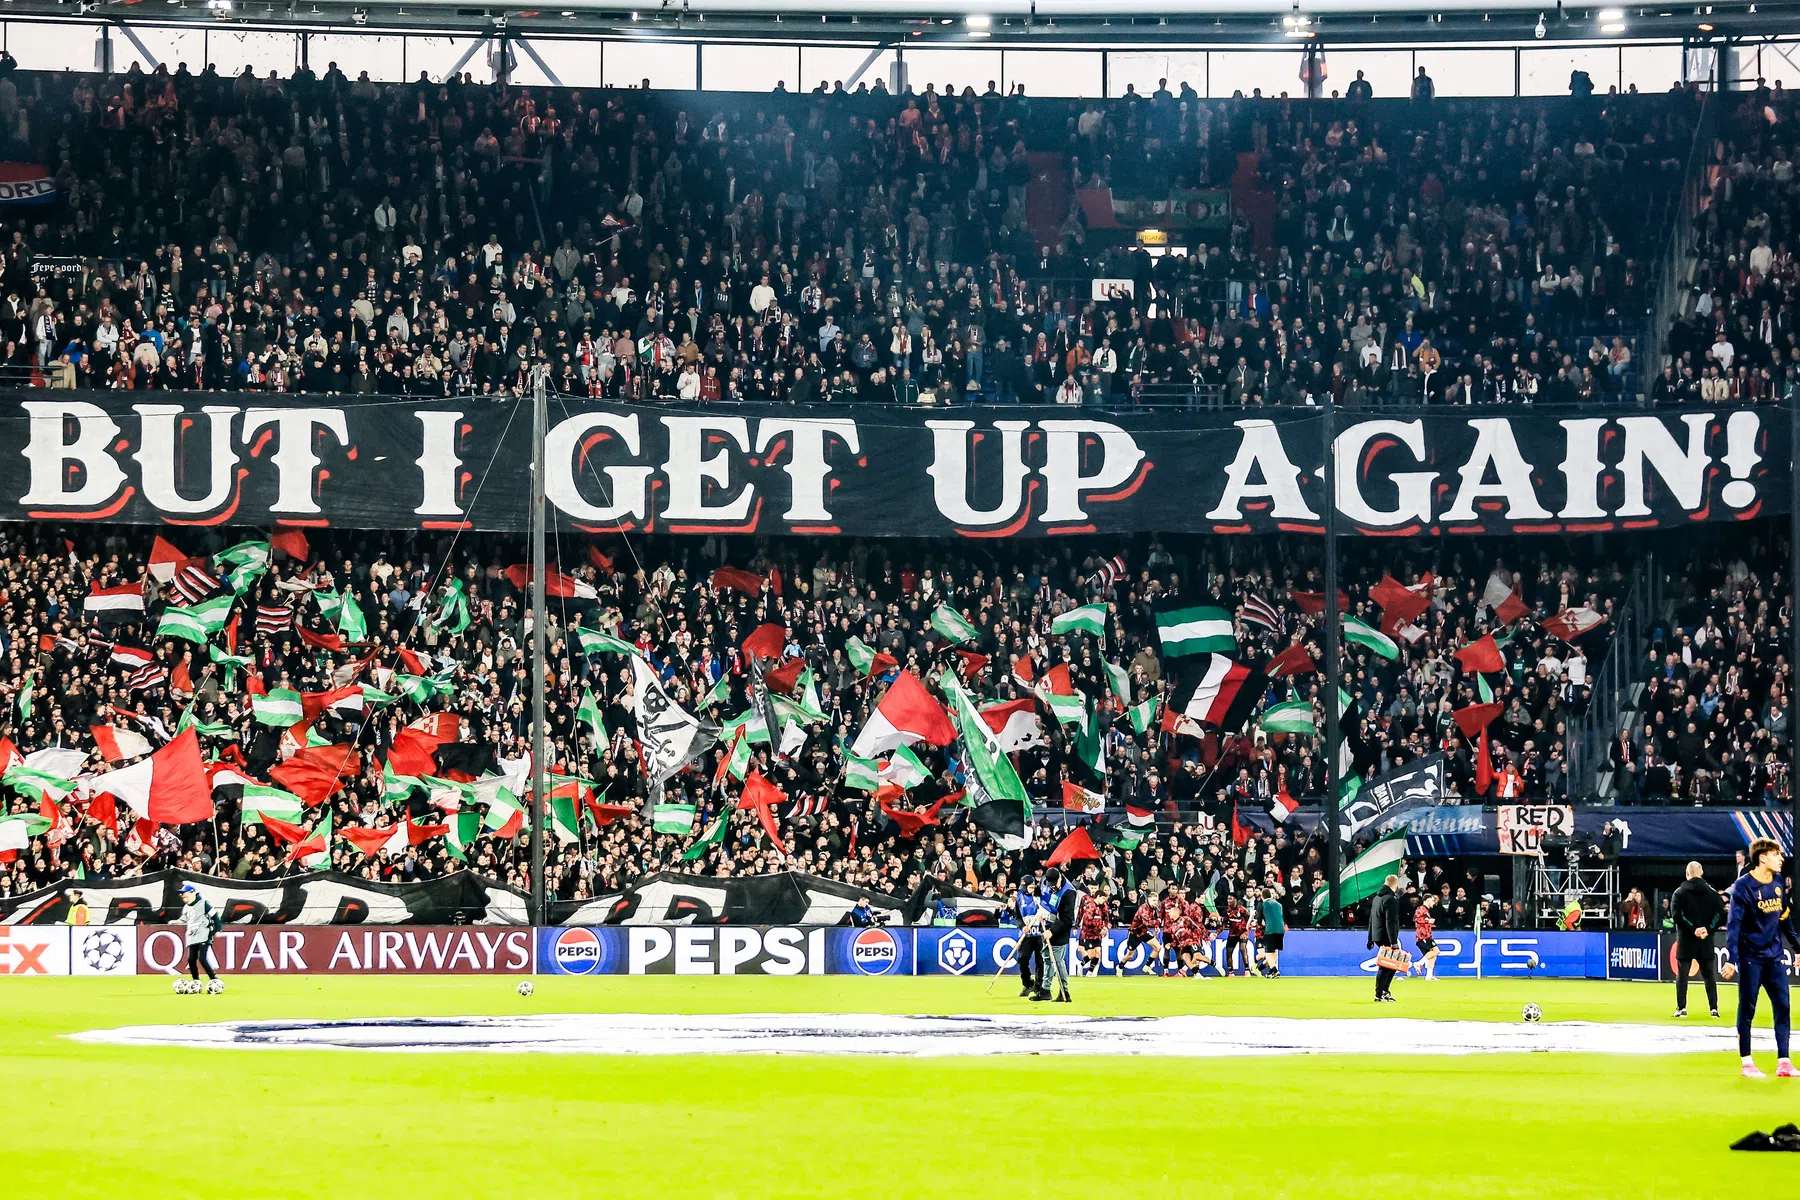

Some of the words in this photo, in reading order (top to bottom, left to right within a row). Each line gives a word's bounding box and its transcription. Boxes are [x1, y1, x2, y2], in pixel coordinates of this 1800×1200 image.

[30, 262, 82, 274] Feyeoord
[19, 402, 350, 515] BUT
[414, 411, 466, 515] I
[544, 411, 861, 526] GET
[925, 418, 1147, 526] UP
[1206, 411, 1764, 526] AGAIN!
[1516, 806, 1564, 828] RED
[328, 931, 529, 970] AIRWAYS
[558, 946, 598, 956] PEPSI
[629, 927, 825, 974] PEPSI
[855, 946, 894, 956] PEPSI
[1611, 947, 1657, 969] #FOOTBALL
